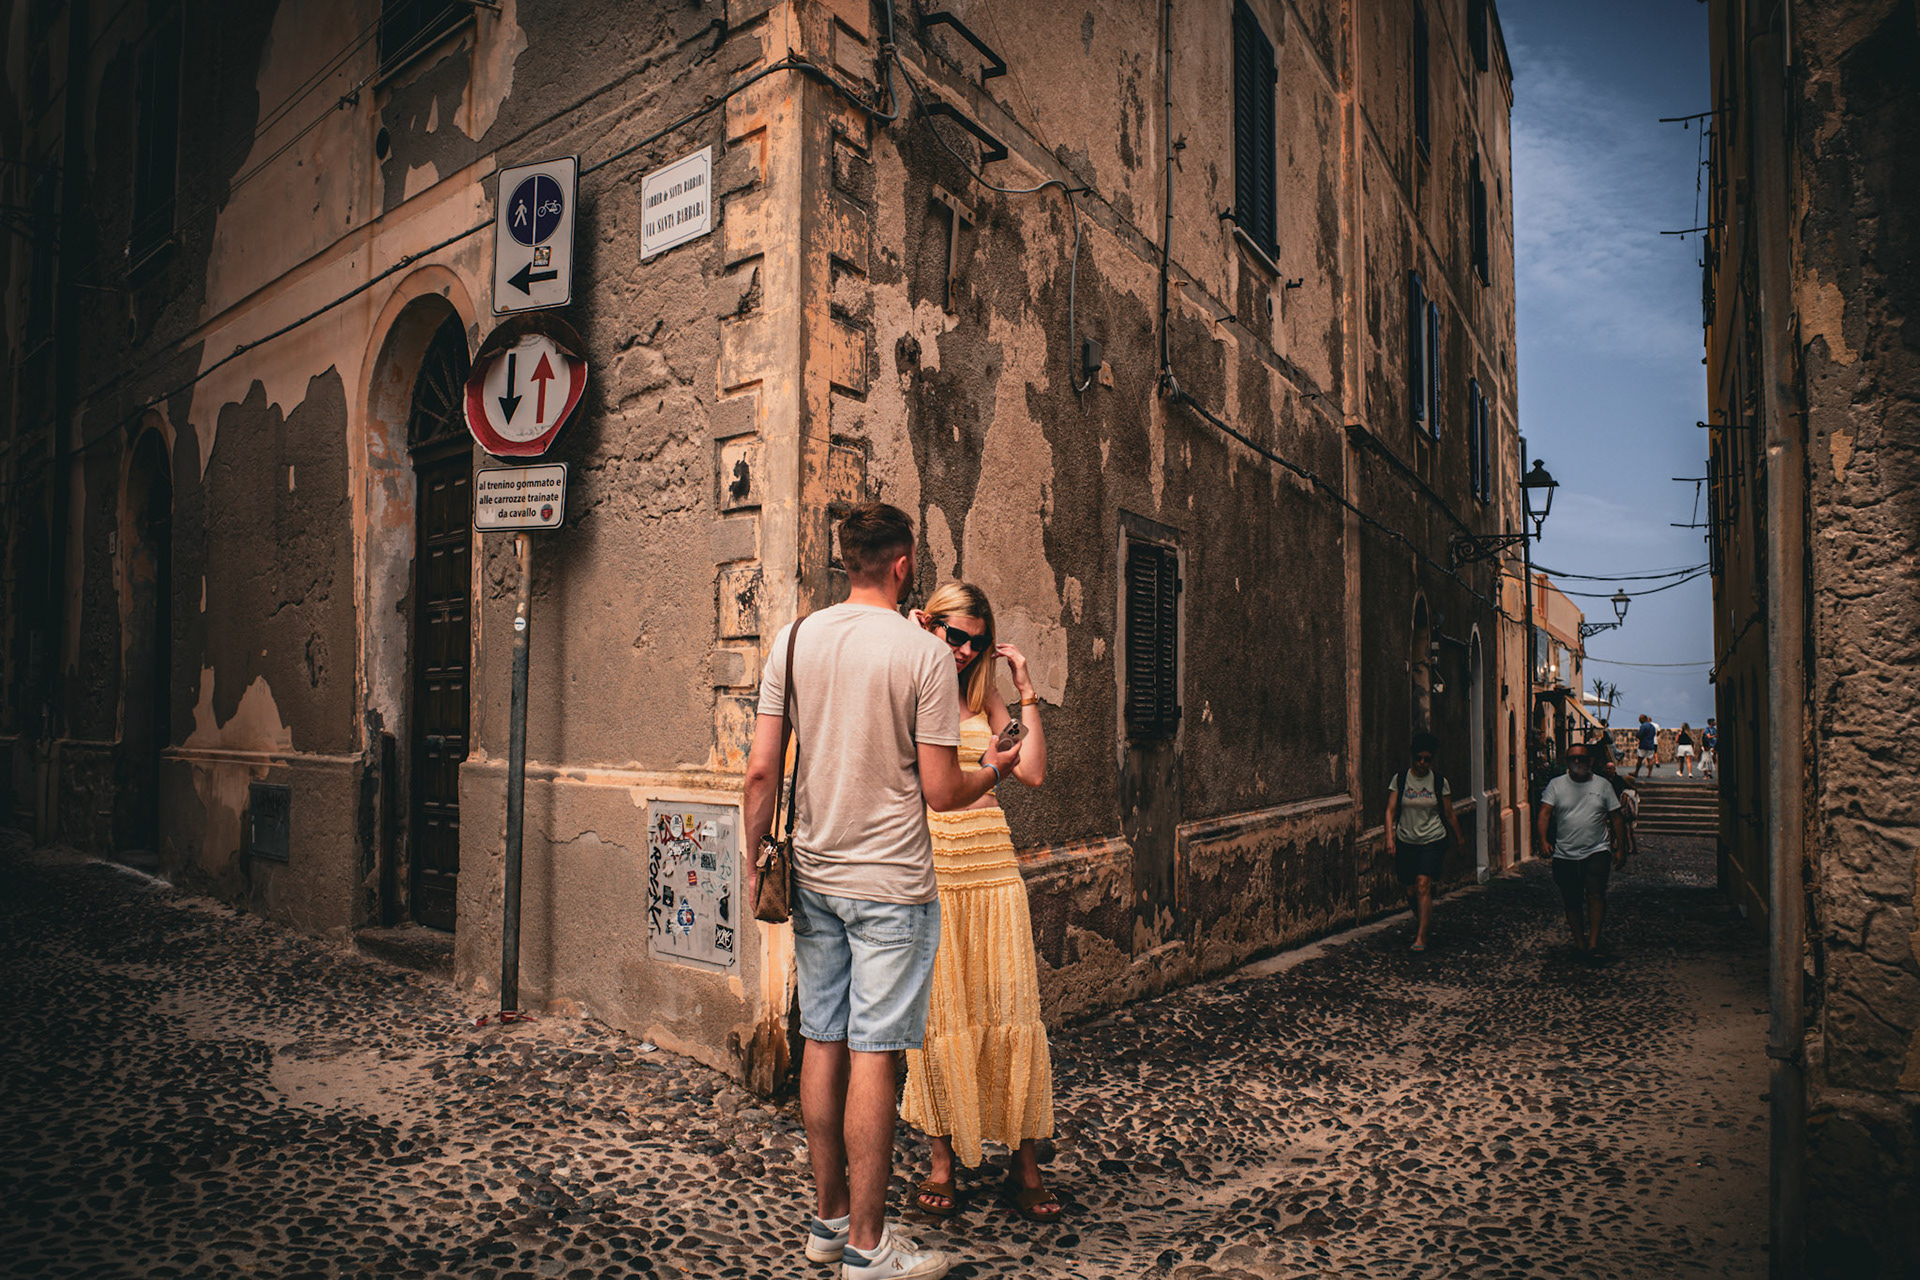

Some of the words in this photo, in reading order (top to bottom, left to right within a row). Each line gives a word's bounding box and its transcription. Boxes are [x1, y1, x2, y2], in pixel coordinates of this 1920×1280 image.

[646, 192, 662, 209] CARRER
[669, 183, 682, 199] SANTA
[683, 173, 705, 192] BARBARA
[645, 222, 655, 238] VIA
[657, 213, 675, 233] SANTA
[676, 200, 705, 225] BARBARA
[479, 480, 486, 490] al
[487, 480, 515, 490] trenino
[516, 478, 555, 490] gommato
[479, 495, 493, 505] alle
[494, 495, 526, 504] carrozze
[527, 492, 559, 502] trainate
[498, 508, 508, 518] da
[509, 507, 537, 518] cavallo
